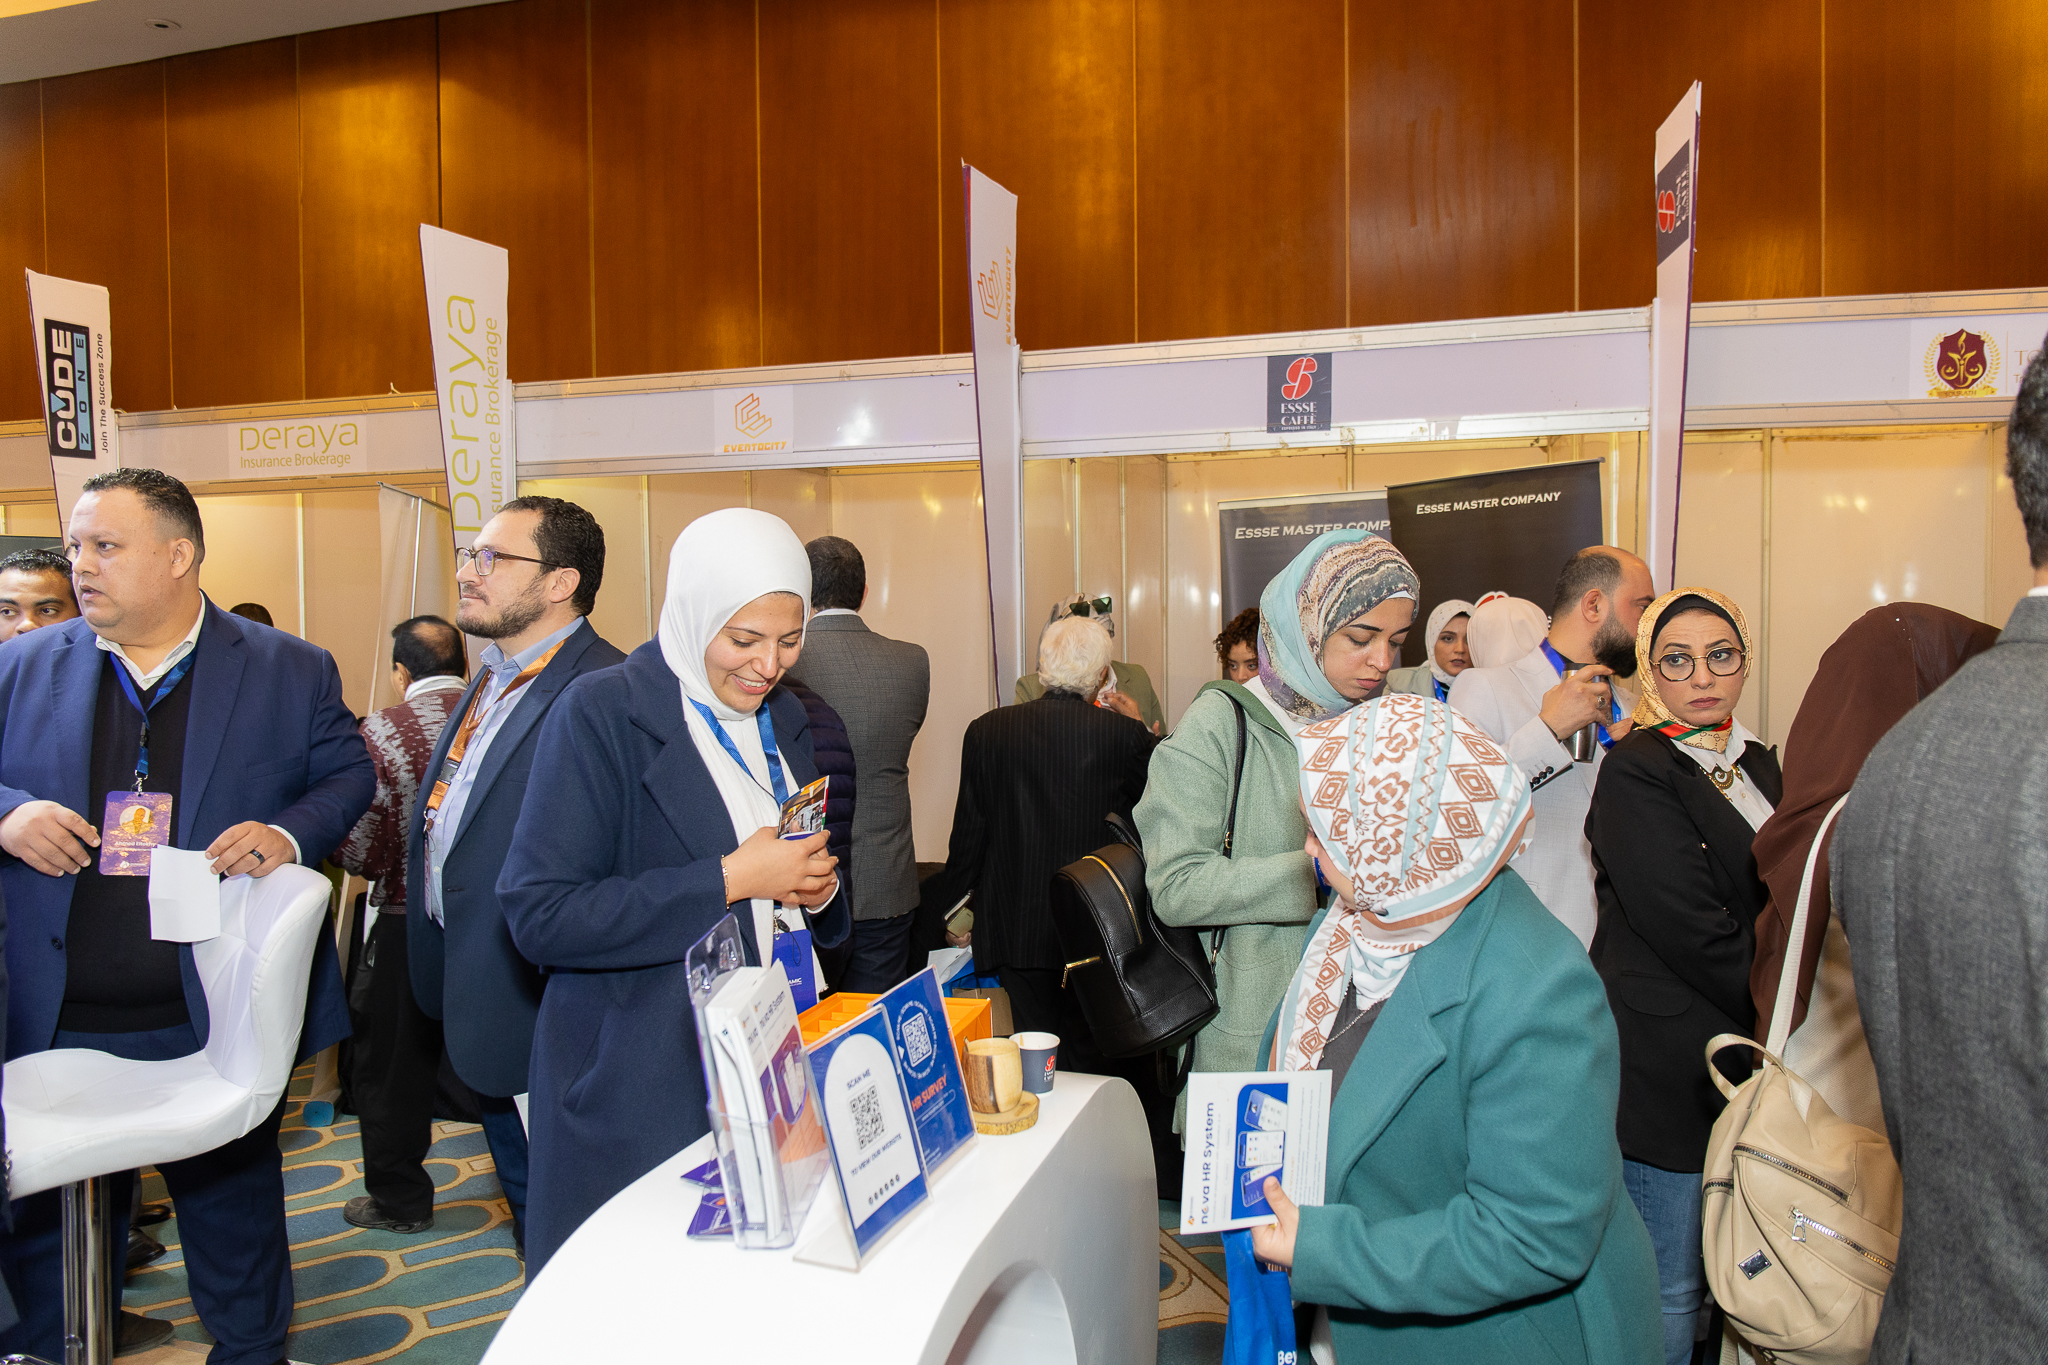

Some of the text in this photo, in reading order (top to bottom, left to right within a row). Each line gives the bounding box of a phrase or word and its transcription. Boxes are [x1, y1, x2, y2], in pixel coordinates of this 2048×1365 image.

[76, 337, 89, 444] ZONE
[484, 317, 502, 514] surance Brokerage
[1281, 402, 1317, 414] ESSSE
[723, 441, 787, 453] EVENTOCITY
[240, 453, 351, 468] Insurance Brokerage
[1416, 492, 1562, 515] ESSSE MASTER COMPANY
[1234, 526, 1280, 540] ESSSE
[1346, 520, 1392, 531] COMP
[911, 1095, 922, 1112] HR
[922, 1074, 947, 1104] SURVEY
[1204, 1102, 1215, 1158] System
[1202, 1162, 1211, 1182] HR
